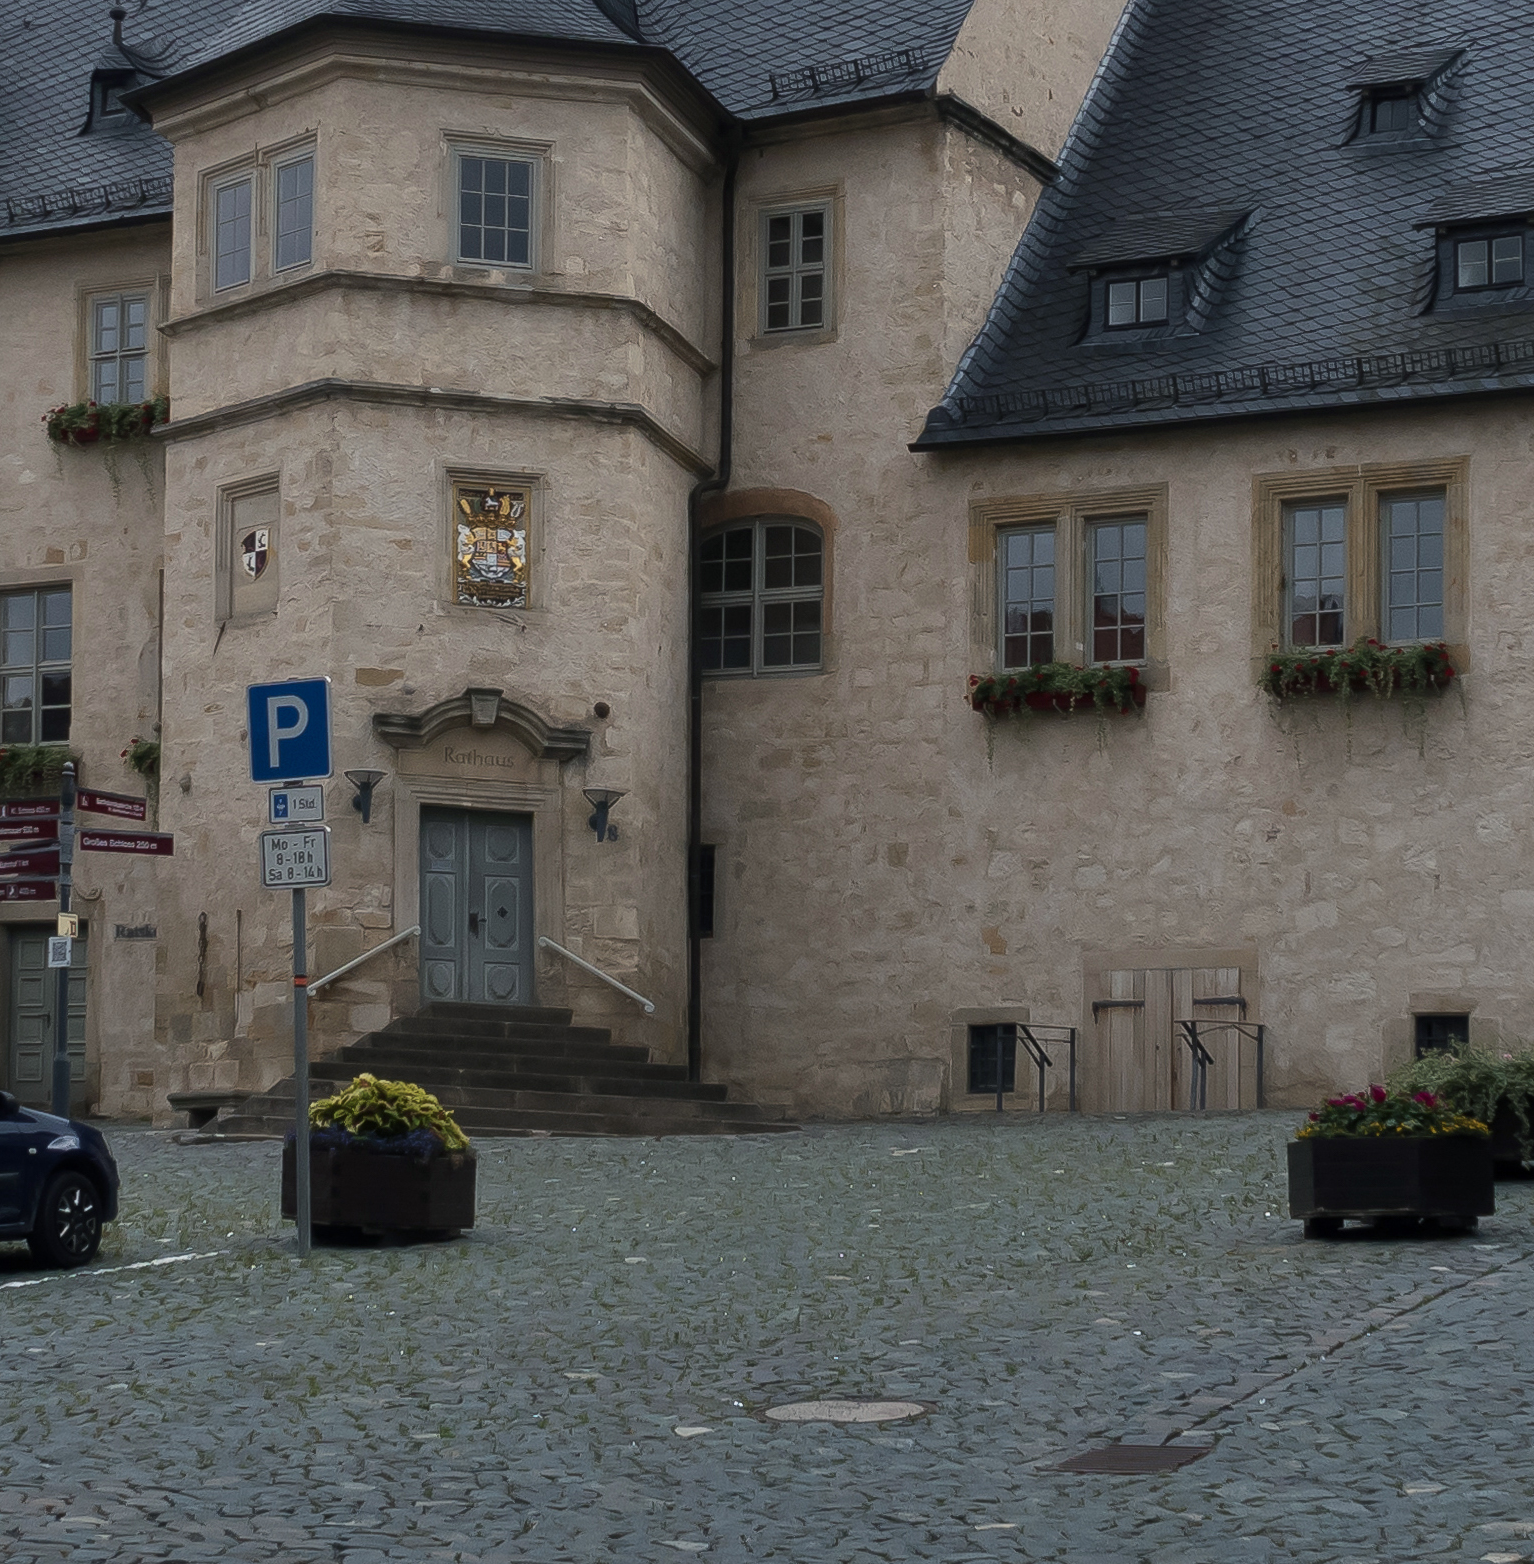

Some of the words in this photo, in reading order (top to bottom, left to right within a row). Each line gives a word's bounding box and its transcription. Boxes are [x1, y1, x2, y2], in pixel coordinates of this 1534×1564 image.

[267, 695, 309, 768] P
[444, 746, 515, 768] Rathaus
[271, 838, 288, 851] Mo
[303, 835, 317, 849] Fr
[268, 868, 283, 882] Sa
